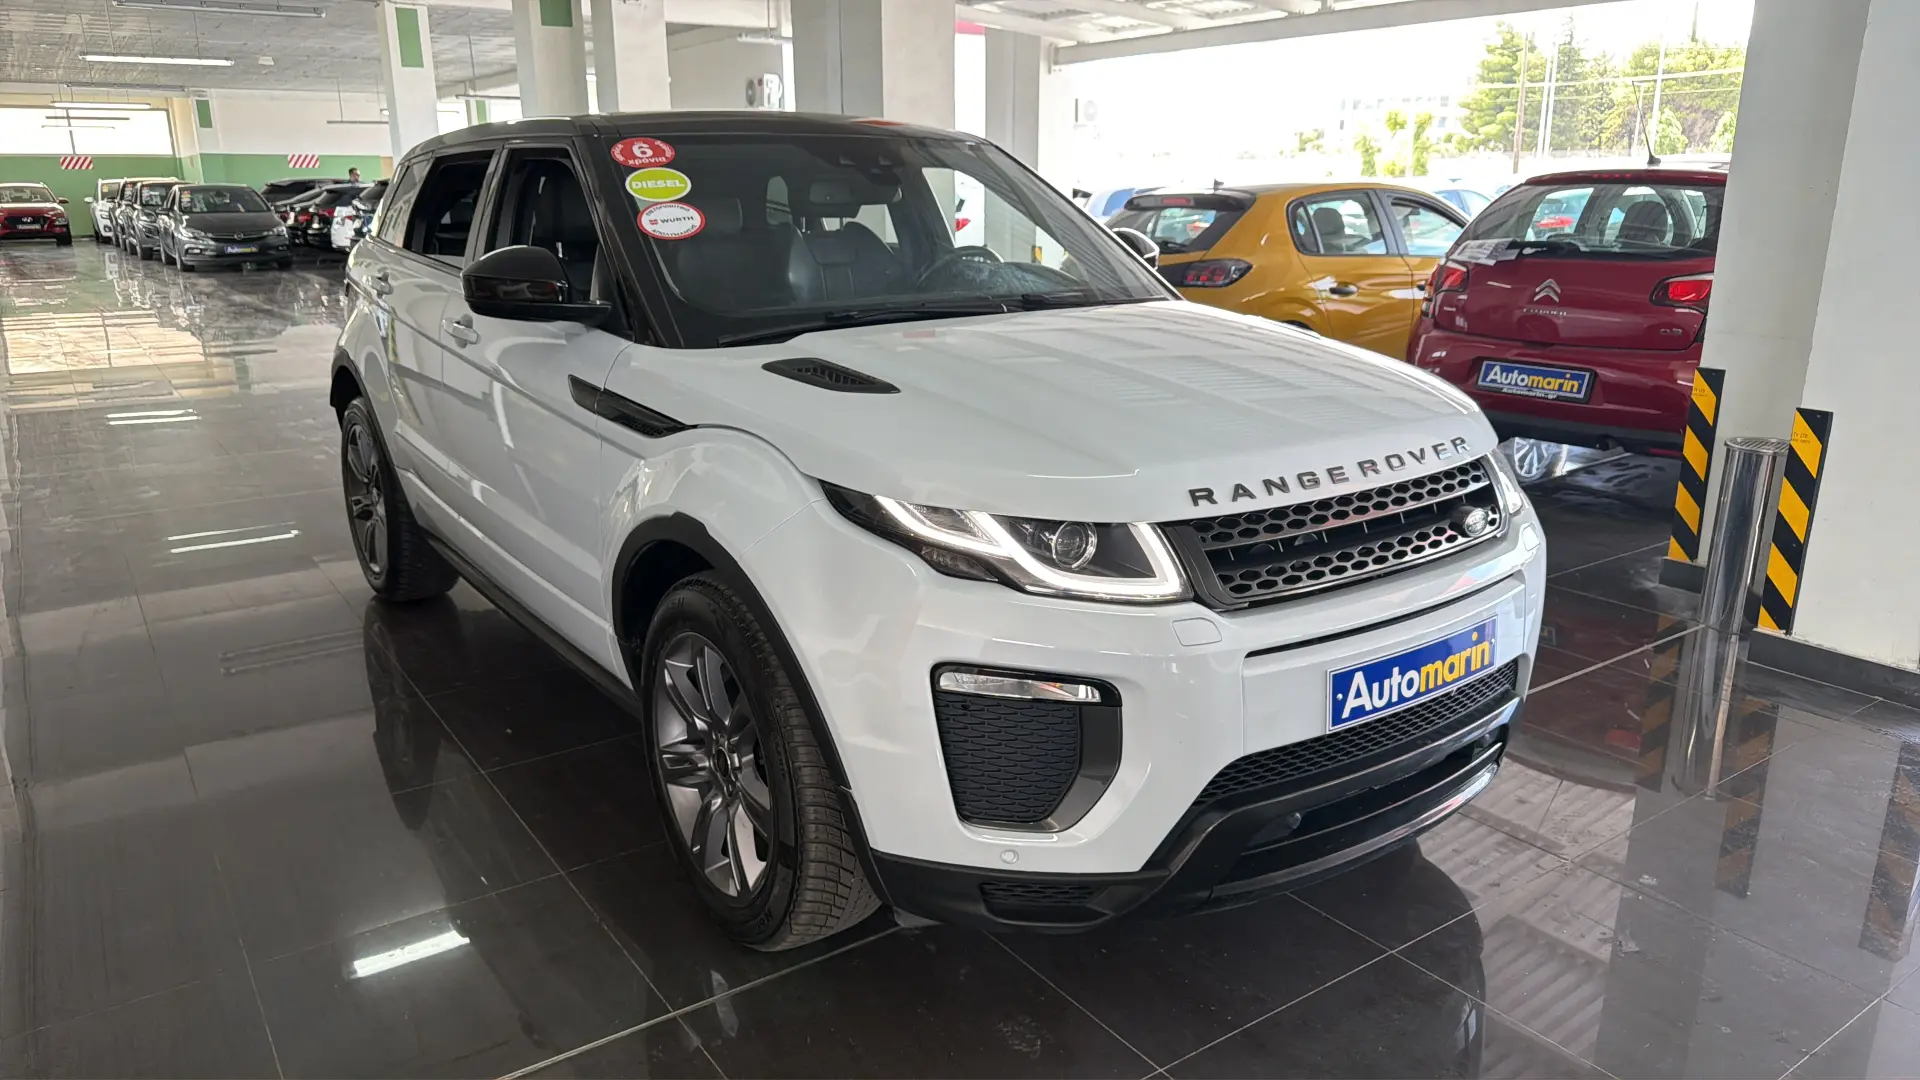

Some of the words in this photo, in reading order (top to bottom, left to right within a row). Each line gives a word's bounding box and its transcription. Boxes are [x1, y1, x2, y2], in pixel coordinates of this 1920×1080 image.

[632, 143, 653, 157] 6
[632, 180, 685, 189] DIESEL
[1485, 365, 1579, 393] Automarin
[1188, 465, 1350, 507] RANGE
[1357, 436, 1471, 477] ROVER
[1342, 631, 1490, 719] Automarin
